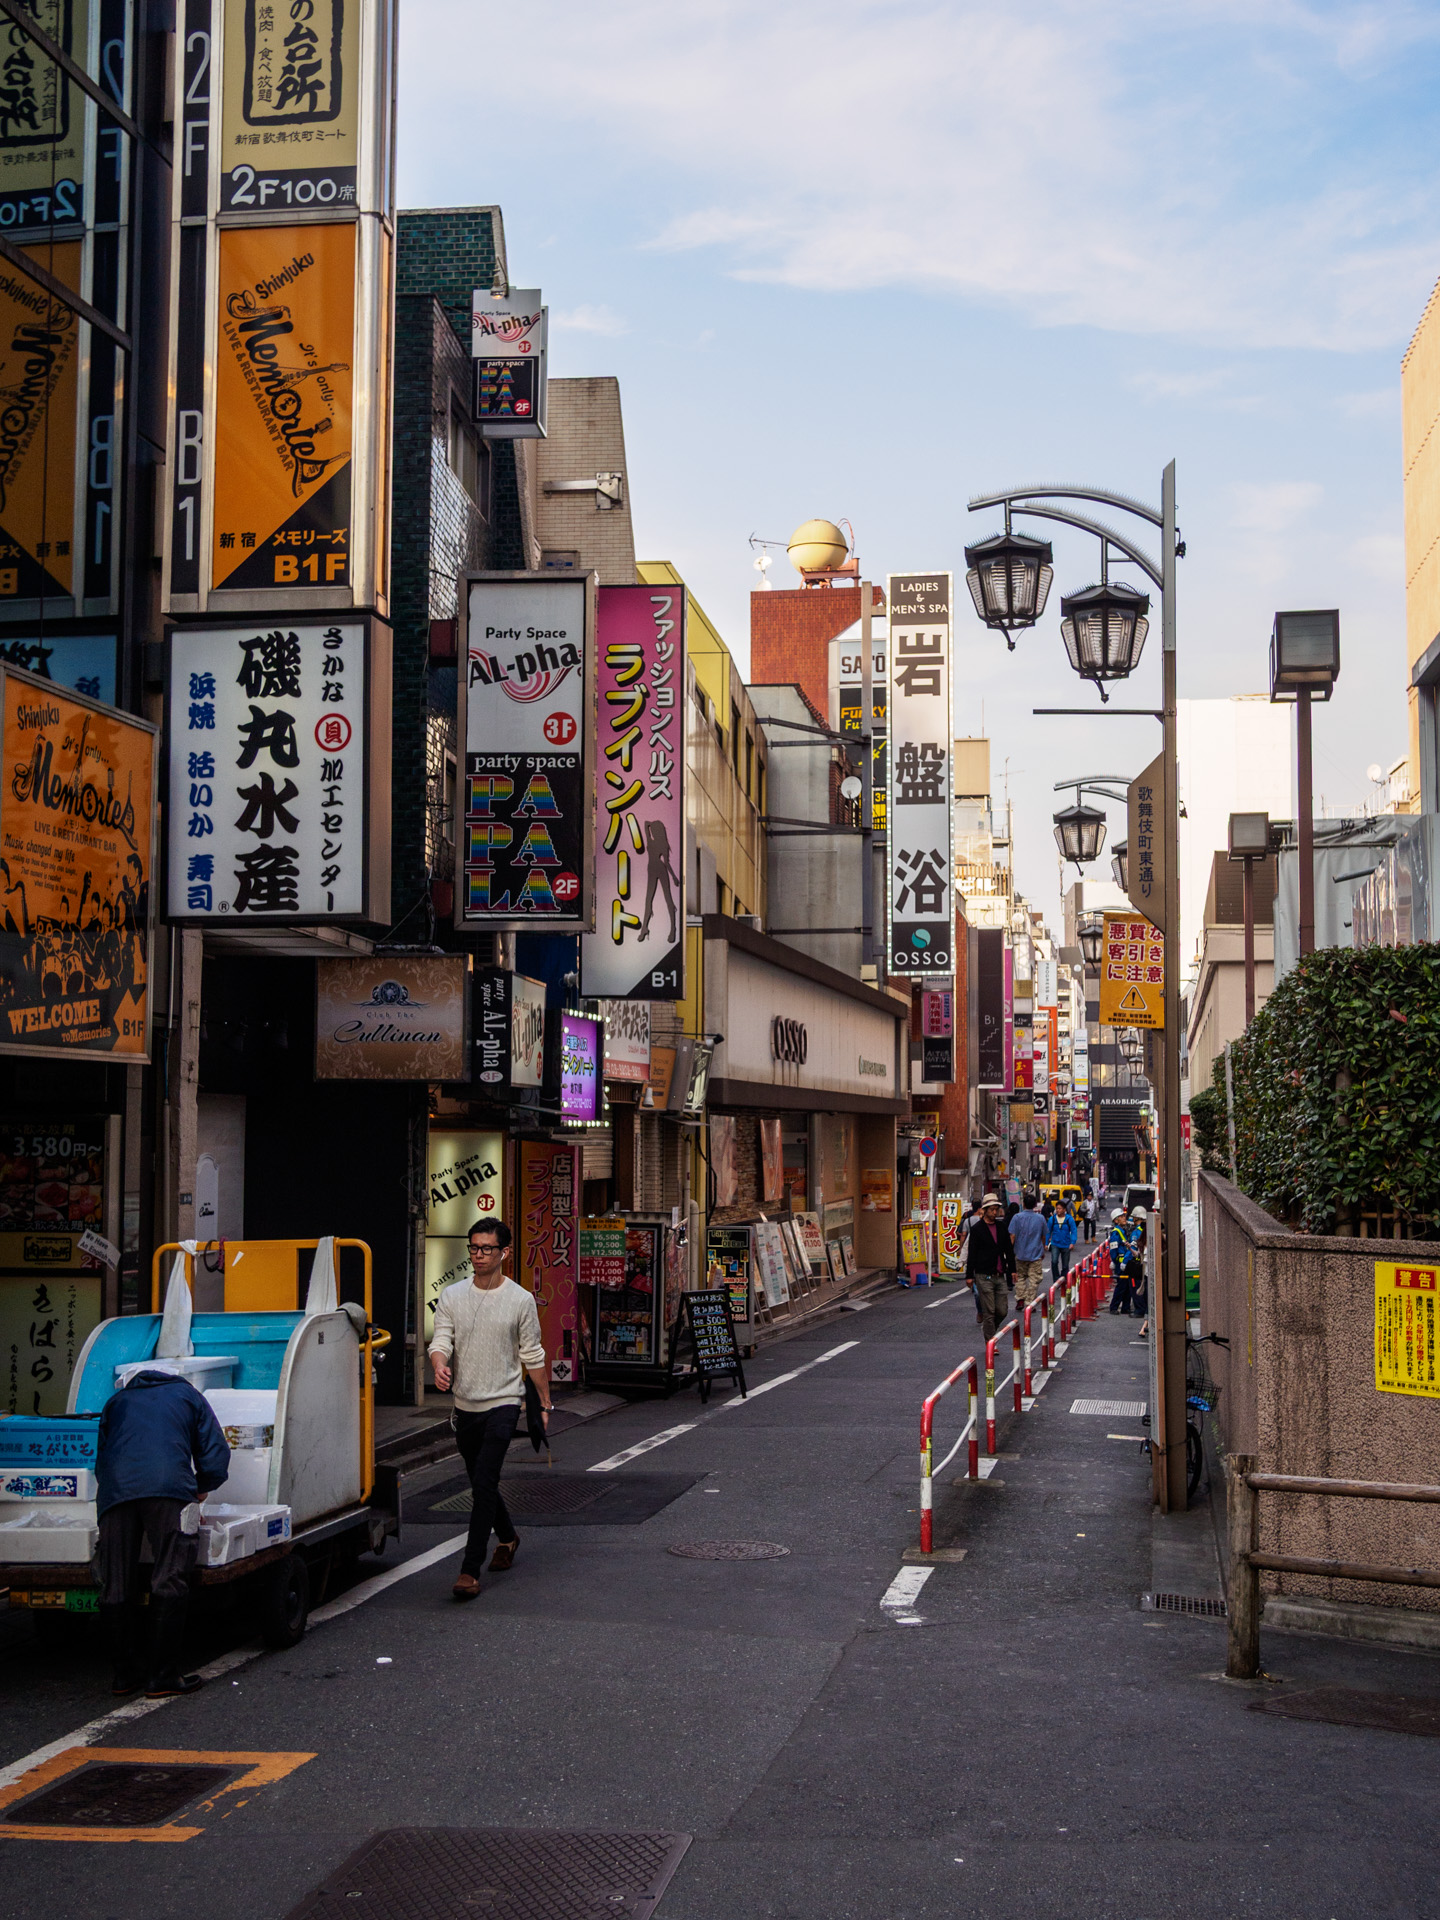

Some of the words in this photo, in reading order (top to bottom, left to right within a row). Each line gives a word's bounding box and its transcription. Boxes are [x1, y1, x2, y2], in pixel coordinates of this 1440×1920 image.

[254, 252, 315, 300] Shinjuku
[480, 314, 533, 339] AL-pha
[222, 320, 244, 352] LIVE
[239, 360, 283, 442] RESTAURANT
[275, 441, 296, 473] BAR
[515, 402, 530, 412] 2F
[219, 531, 257, 549] 新宿
[271, 527, 348, 547] メモリーズ
[273, 552, 348, 583] B1F
[900, 582, 940, 593] LADIES
[915, 593, 926, 603] &
[891, 604, 927, 615] MEN'S
[928, 603, 949, 614] SPA
[484, 626, 523, 643] Party
[526, 626, 568, 643] Space
[321, 626, 345, 702] さかな
[468, 642, 582, 690] AL-pha
[187, 671, 217, 731] 浜焼
[648, 594, 676, 801] ファッションヘルス
[17, 702, 61, 731] Shinjuku
[545, 717, 574, 740] 3F
[233, 630, 302, 914] 磯丸水産
[473, 754, 523, 774] party
[525, 755, 577, 773] space
[894, 632, 949, 914] 岩盤浴
[187, 751, 216, 839] 活いか
[465, 773, 564, 818] PA
[602, 642, 650, 946] ラブインハート
[34, 820, 51, 836] LIVE
[320, 757, 344, 912] 加工センター
[465, 821, 563, 867] PA
[1137, 785, 1155, 899] 歌舞伎町東通り
[186, 853, 215, 913] 寿司
[555, 878, 578, 895] 2F
[1108, 923, 1163, 941] 悪質な
[894, 951, 949, 967] OSSO
[1107, 942, 1162, 962] 客引き
[650, 969, 678, 988] B-1
[1106, 963, 1163, 983] に注意
[479, 982, 493, 1007] space
[493, 977, 507, 1002] party
[8, 999, 101, 1035] WELCOME
[122, 1018, 145, 1038] B1F
[332, 1019, 443, 1044] Cullinan
[482, 1071, 501, 1082] 3F
[430, 1165, 454, 1183] Party
[454, 1153, 480, 1171] Space
[477, 1196, 495, 1209] 3F
[550, 1153, 572, 1268] 店舗型ヘルス
[85, 1231, 96, 1243] We
[95, 1237, 109, 1251] Have
[525, 1158, 551, 1307] ラブインハート
[941, 1215, 960, 1254] トイレ
[80, 1241, 89, 1251] An
[88, 1245, 108, 1261] English
[431, 1264, 456, 1292] party
[1399, 1270, 1431, 1288] 警告
[28, 1442, 95, 1457] ながいも
